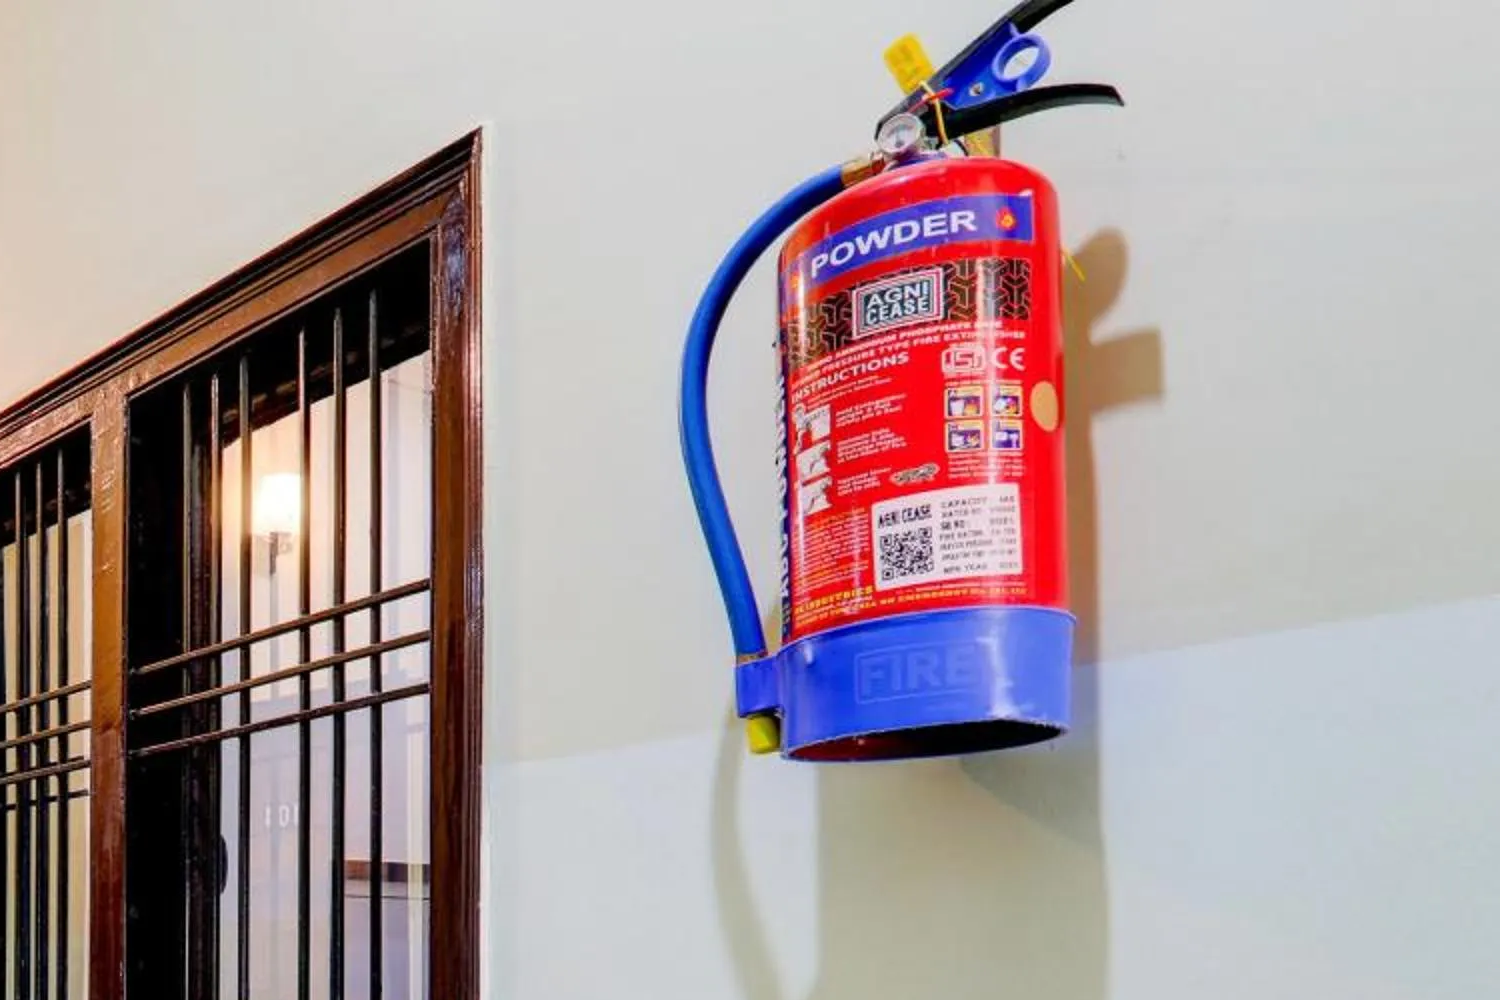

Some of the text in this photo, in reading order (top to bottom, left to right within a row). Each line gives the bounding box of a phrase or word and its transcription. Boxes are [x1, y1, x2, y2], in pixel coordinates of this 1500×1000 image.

[810, 210, 978, 279] POWDER
[866, 281, 929, 305] AGNI
[866, 299, 930, 326] CEASE
[790, 352, 909, 404] INSTRUCTIONS
[859, 644, 980, 698] FIRE
